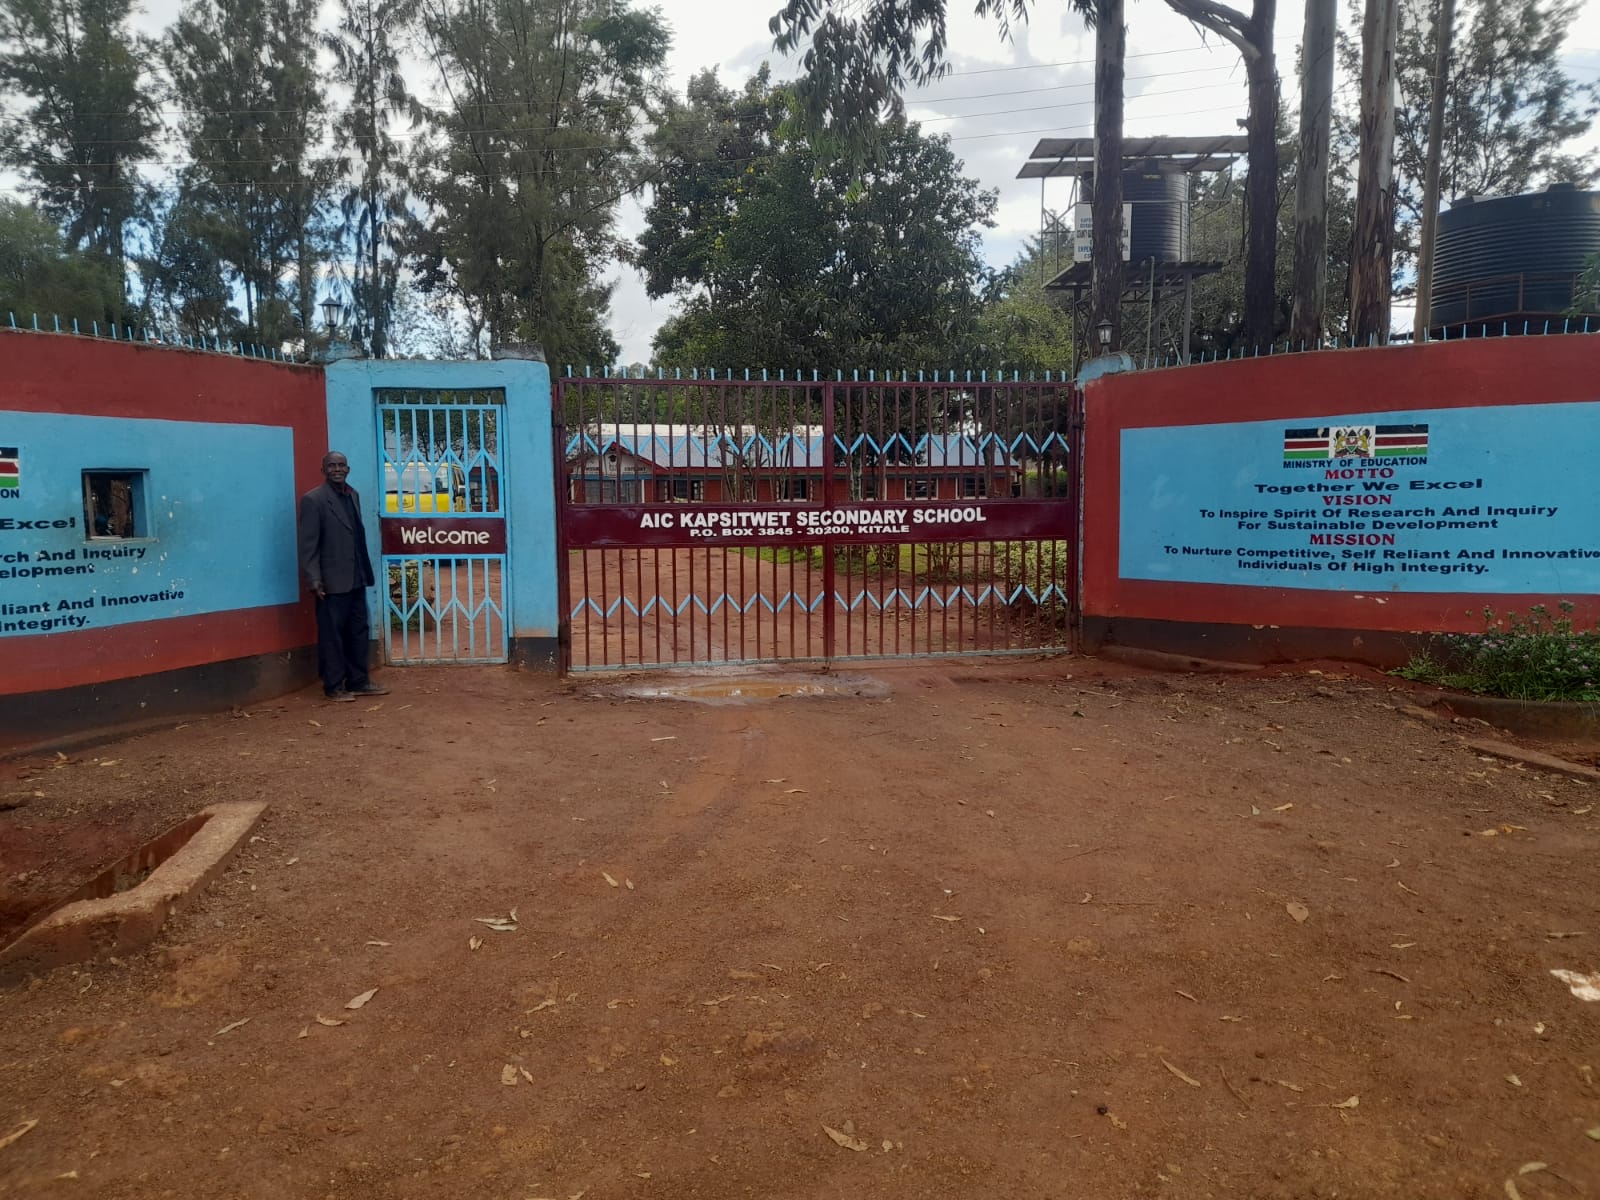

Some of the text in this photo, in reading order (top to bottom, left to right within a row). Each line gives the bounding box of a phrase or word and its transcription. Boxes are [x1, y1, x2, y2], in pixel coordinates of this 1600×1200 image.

[1283, 457, 1427, 468] MINISTRY OF EDUCATION
[1325, 468, 1394, 479] MOTTO
[0, 488, 19, 498] ON
[1255, 479, 1482, 494] Together We Excel
[1322, 495, 1392, 505] VISION
[640, 507, 986, 528] AIC KAPSITWET SECONDARY SCHOOL
[1200, 505, 1558, 519] To Inspire Spirit Of Research And Inquiry
[0, 517, 75, 529] Excel
[1238, 519, 1498, 530] For Sustainable Development
[401, 526, 490, 545] Welcome
[690, 529, 717, 537] P.O.
[722, 528, 753, 536] BOX
[758, 528, 793, 536] 3845
[807, 526, 853, 535] 30200,
[858, 525, 910, 534] KITALE
[1310, 533, 1395, 545] MISSION
[37, 549, 75, 562] And
[83, 546, 146, 560] Inquiry
[1164, 546, 1600, 560] To Nurture Competitive, Self Reliant And Innovative
[1238, 560, 1489, 574] Individuals Of High Integrity.
[57, 597, 94, 611] And
[102, 590, 184, 607] Innovative
